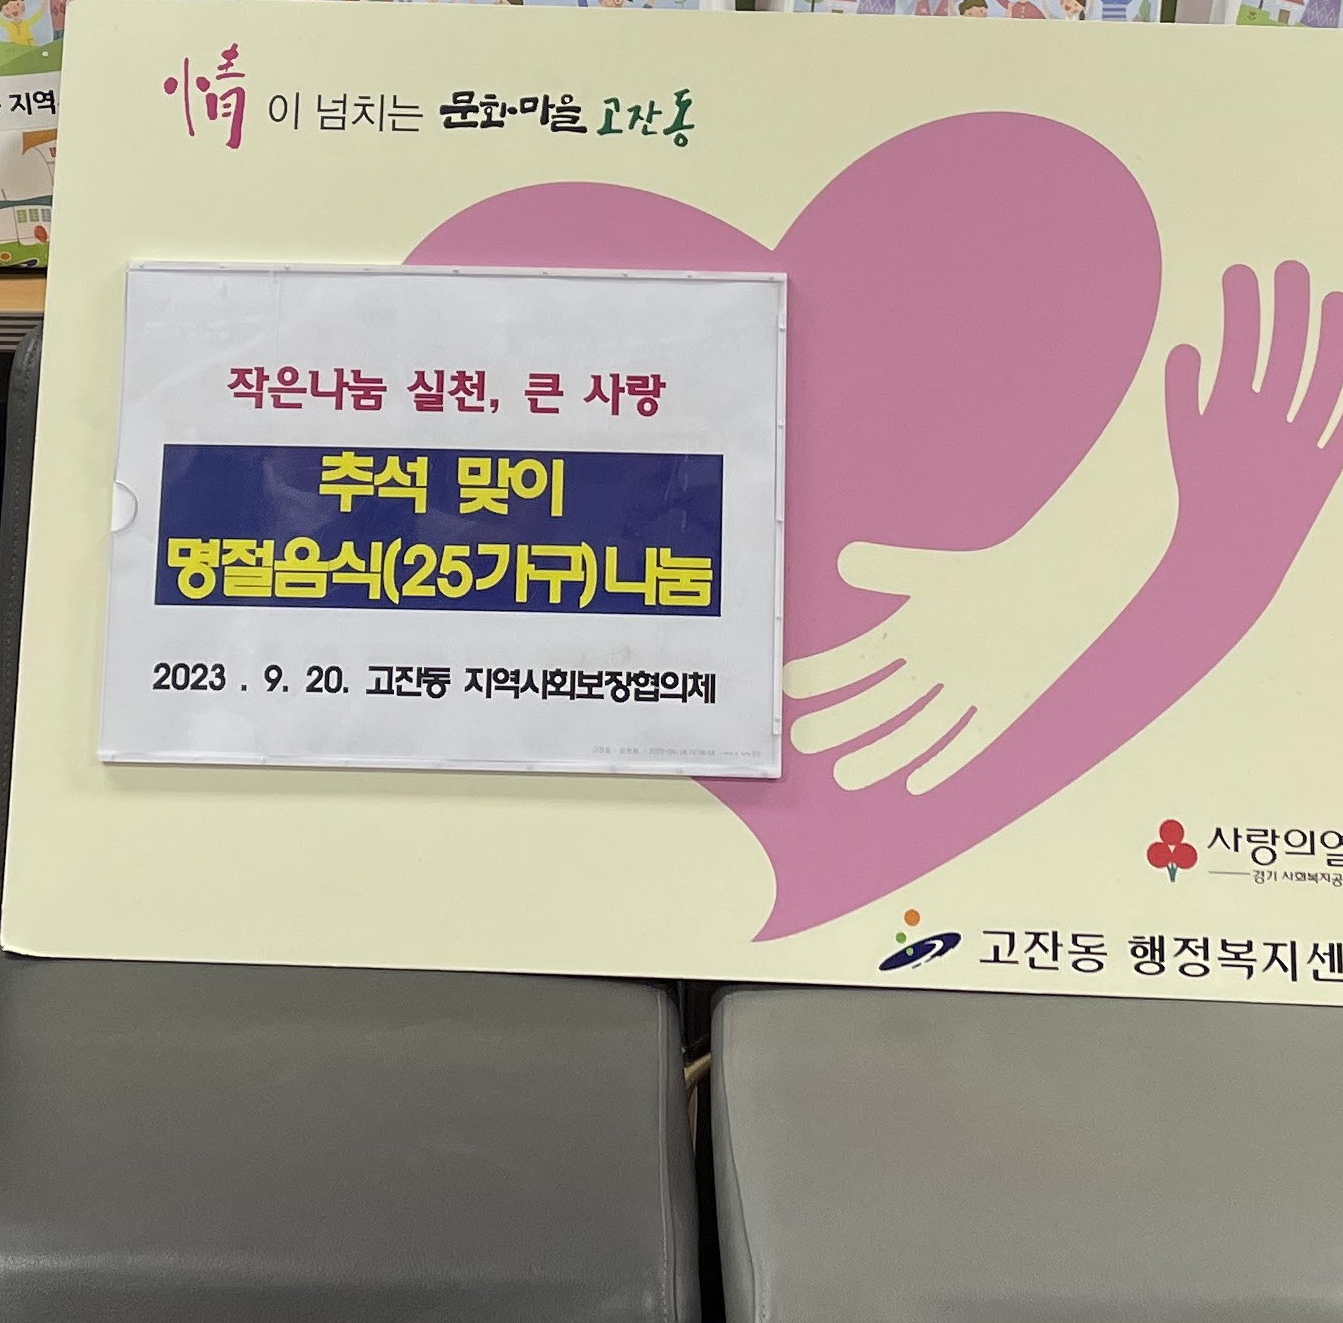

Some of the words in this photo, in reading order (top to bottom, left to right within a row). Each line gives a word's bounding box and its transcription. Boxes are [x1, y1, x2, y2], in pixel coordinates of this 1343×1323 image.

[317, 92, 424, 133] 넘치는
[440, 90, 588, 134] 문화마을
[597, 88, 696, 147] 고잔동
[228, 366, 387, 412] 작은나눔
[407, 368, 499, 414] 실천,
[525, 372, 564, 415] 큰
[583, 372, 667, 417] 사랑
[318, 451, 429, 514] 추석
[456, 455, 565, 517] 맞이
[153, 662, 226, 691] 2023
[264, 664, 289, 693] 9.
[307, 666, 349, 695] 20.
[367, 665, 451, 698] 고잔동
[465, 667, 716, 704] 지역사회보장협의체
[1253, 869, 1278, 884] 경기
[979, 929, 1108, 974] 고잔동
